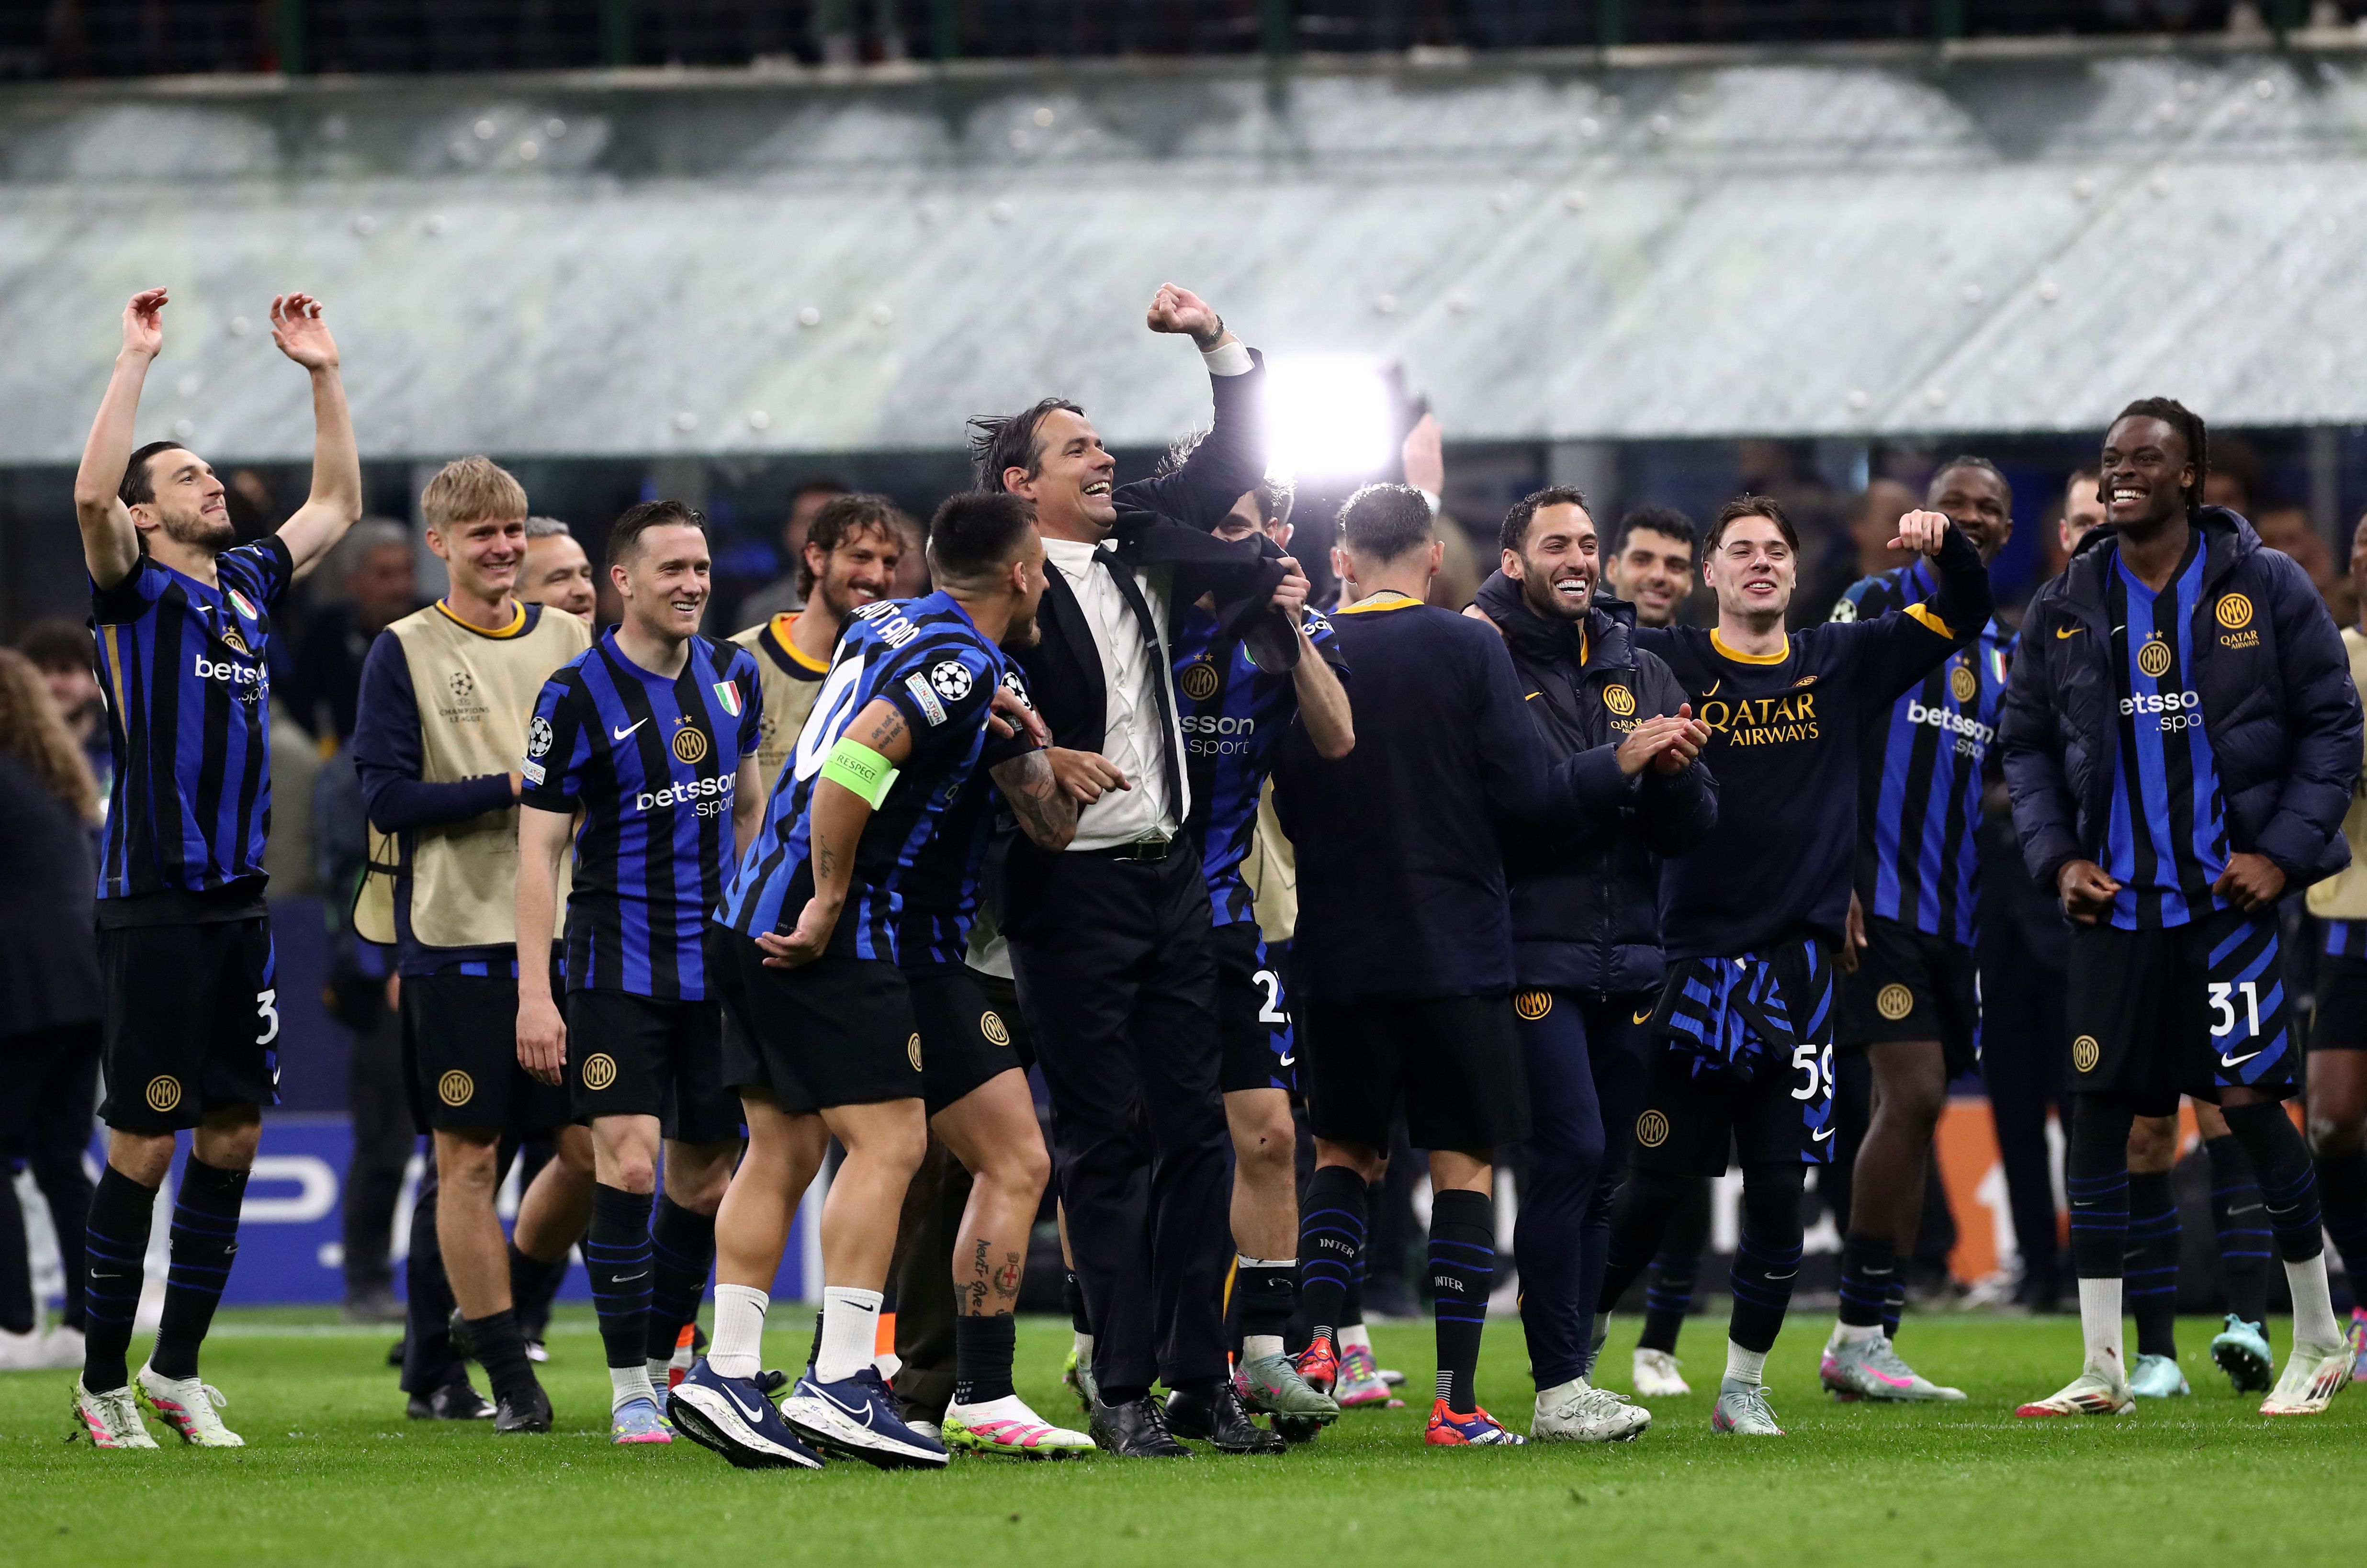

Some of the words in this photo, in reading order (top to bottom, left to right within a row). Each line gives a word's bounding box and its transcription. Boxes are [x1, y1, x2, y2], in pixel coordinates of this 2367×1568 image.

[2220, 629, 2258, 646] QATAR
[2231, 639, 2260, 650] AIRWAYS
[912, 676, 942, 723] FOUNDATION
[2119, 690, 2199, 716] etsso
[1700, 693, 1816, 734] QATAR
[1907, 698, 1995, 745] betsson
[2155, 713, 2202, 734] .spo
[1729, 722, 1819, 747] AIRWAYS
[837, 754, 876, 781] RESPECT
[636, 772, 736, 811] betsson
[2208, 982, 2259, 1037] 31
[1791, 1043, 1833, 1100] 59
[1319, 1238, 1354, 1258] INTER
[1435, 1276, 1465, 1292] INTER
